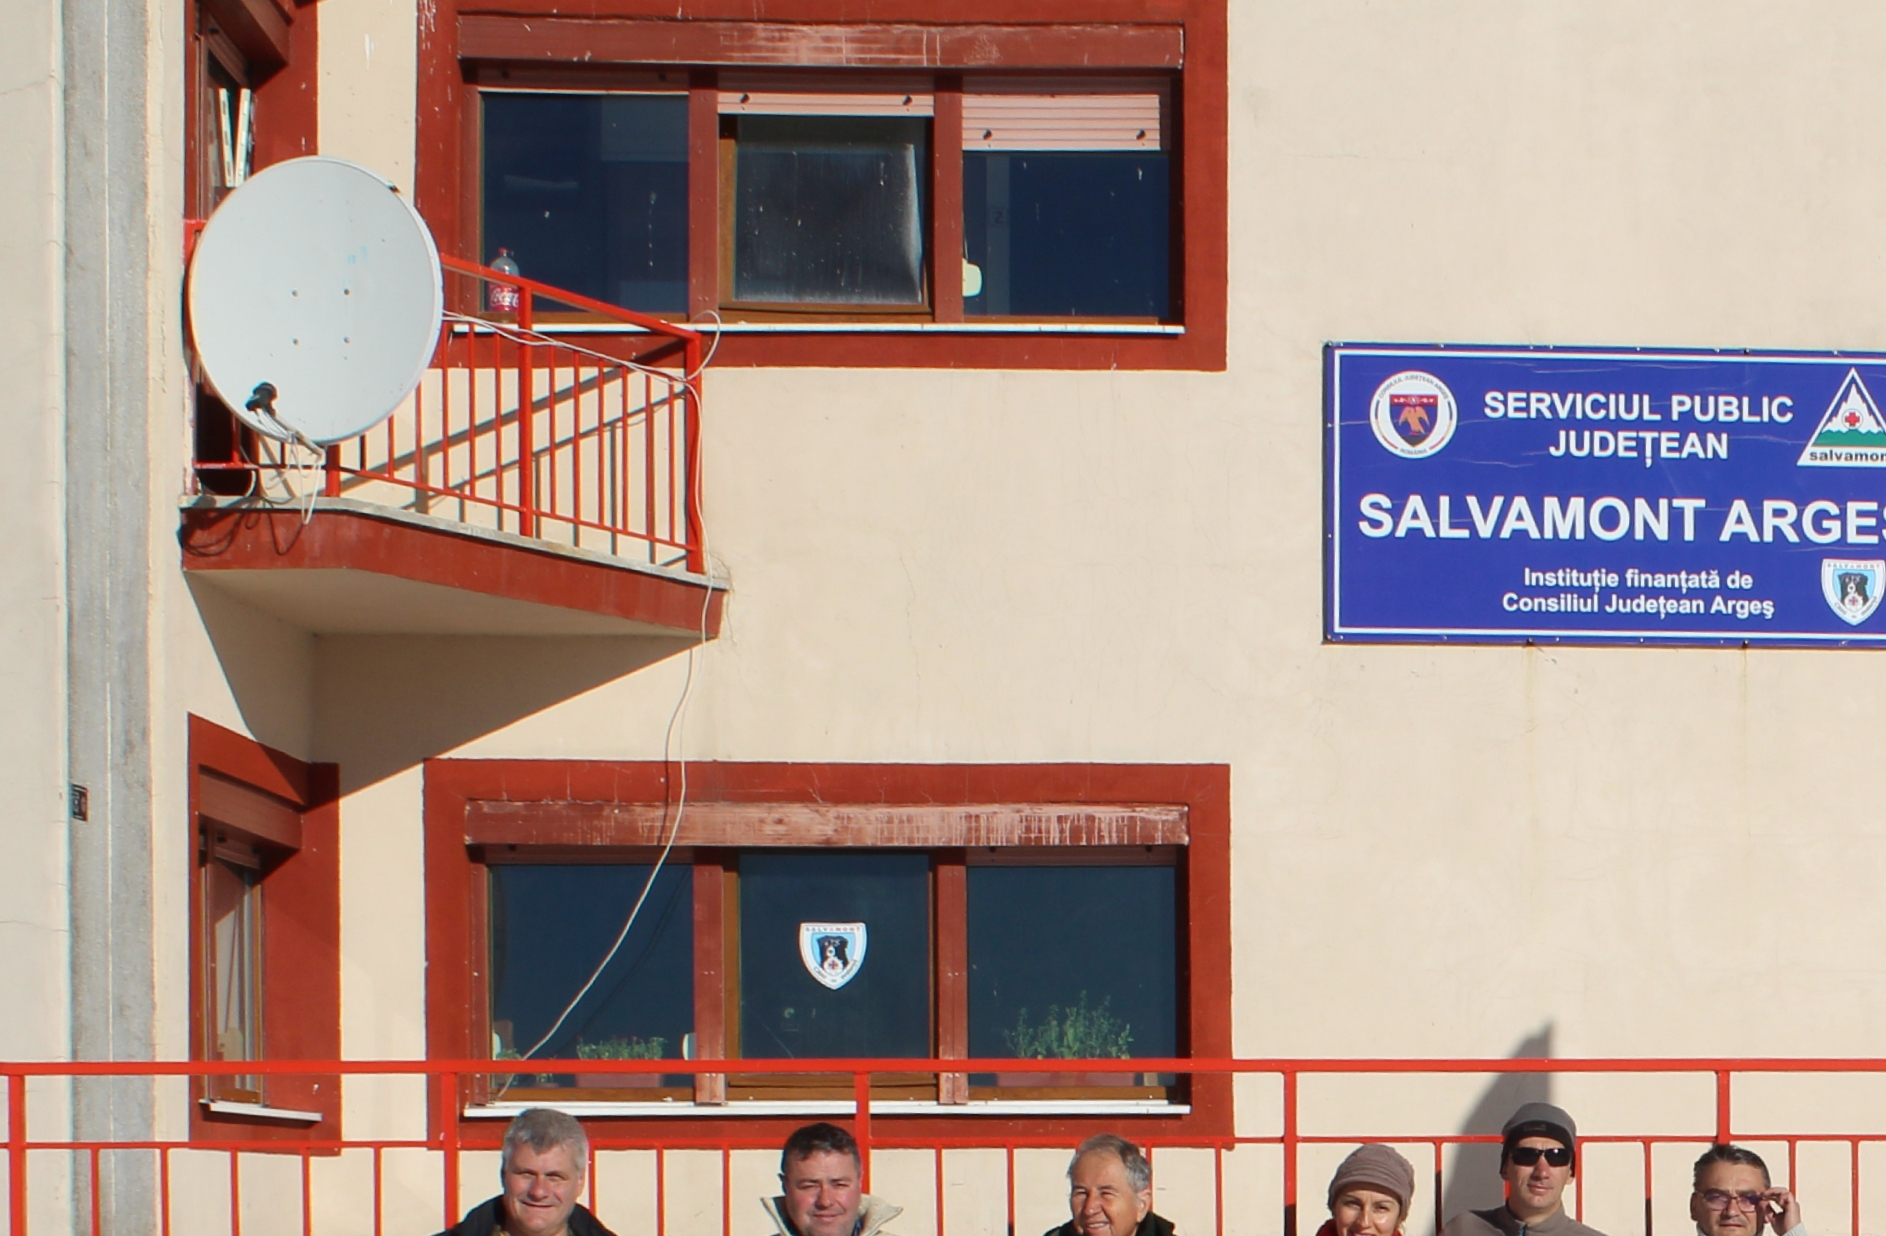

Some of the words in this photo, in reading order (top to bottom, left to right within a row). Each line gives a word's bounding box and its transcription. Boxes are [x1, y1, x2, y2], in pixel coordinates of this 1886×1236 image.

[1484, 390, 1662, 421] SERVICIUL
[1671, 393, 1793, 423] PUBLIC
[1358, 492, 1706, 542] SALVAMONT
[1726, 569, 1753, 589] de
[1502, 591, 1599, 613] Consiliul
